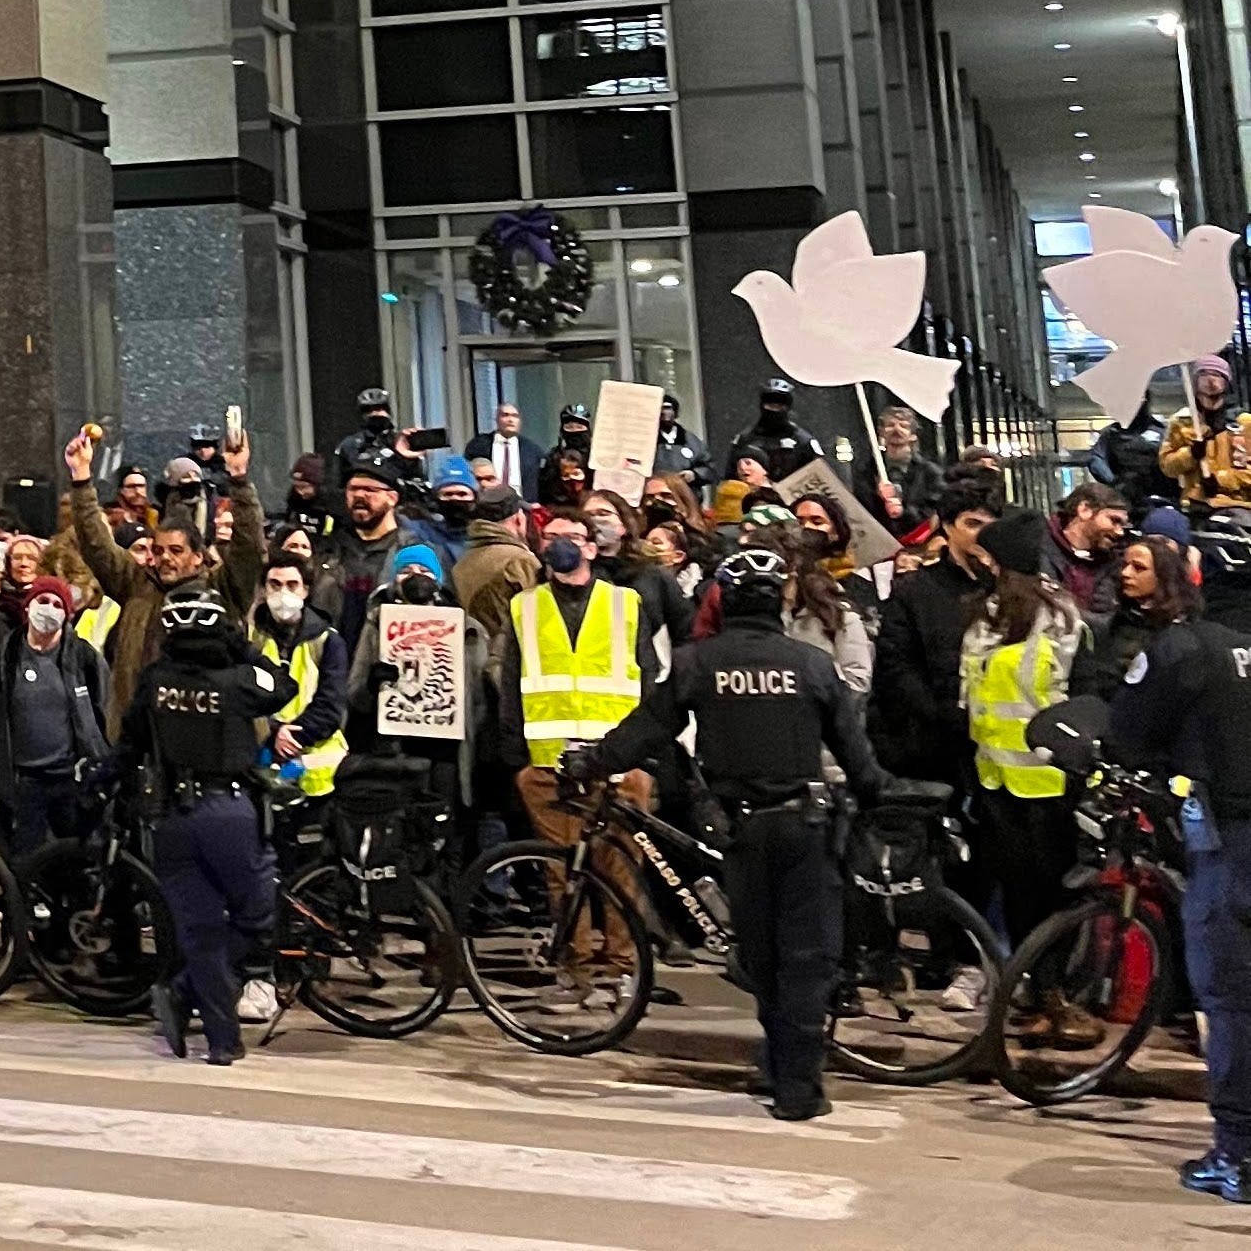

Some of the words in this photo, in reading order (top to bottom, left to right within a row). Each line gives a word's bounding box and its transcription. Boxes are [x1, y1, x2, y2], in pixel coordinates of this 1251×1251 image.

[715, 670, 797, 694] POLICE
[157, 687, 220, 713] POLICE
[633, 832, 681, 886] CHICAGO
[676, 888, 718, 936] POLICE
[854, 874, 925, 896] POLICE
